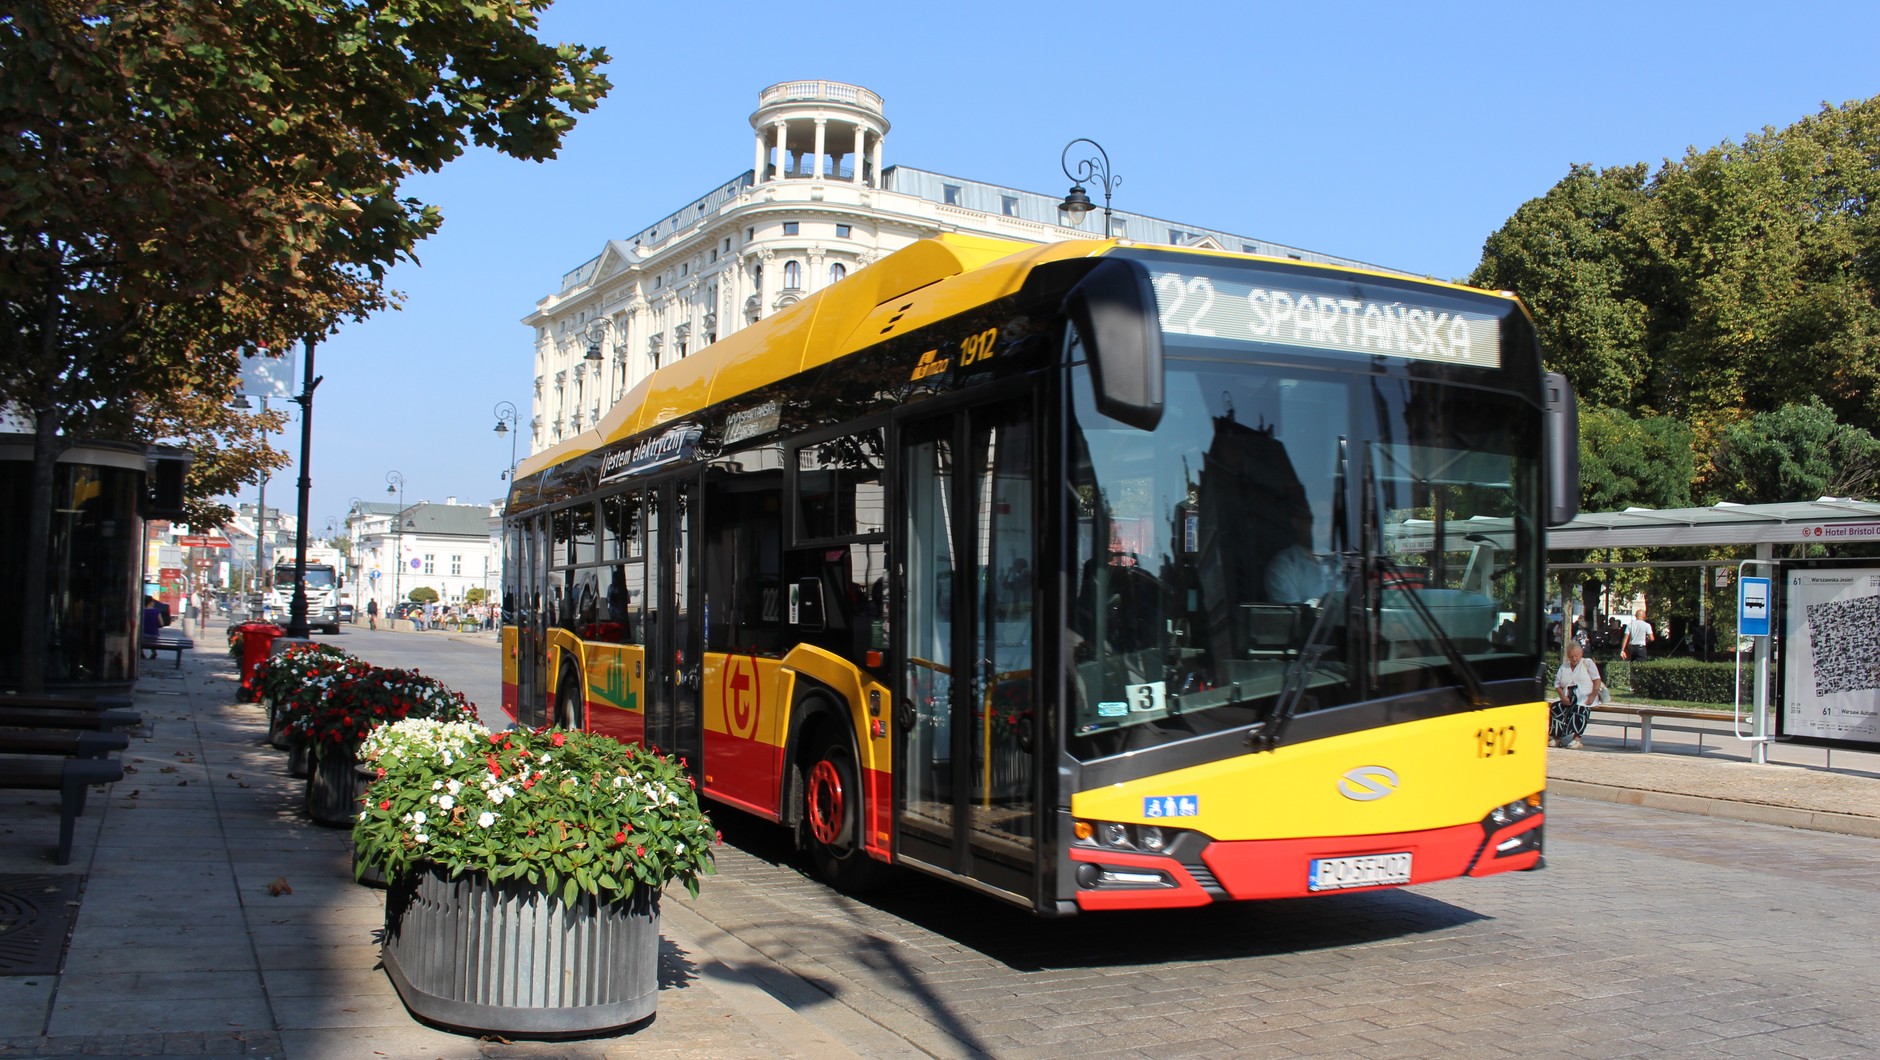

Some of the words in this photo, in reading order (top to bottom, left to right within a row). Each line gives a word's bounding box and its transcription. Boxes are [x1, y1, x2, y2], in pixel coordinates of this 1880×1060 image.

[1150, 272, 1216, 336] 22
[1247, 288, 1472, 359] SPARTAŃSKA
[960, 327, 998, 367] 1912
[602, 449, 632, 477] jestem
[632, 431, 687, 461] elektryczny
[1825, 528, 1847, 536] Hotel
[1849, 527, 1875, 536] Bristol
[1793, 577, 1801, 586] 61
[1137, 685, 1154, 709] 3
[1822, 707, 1831, 716] 61
[1475, 725, 1517, 758] 1912
